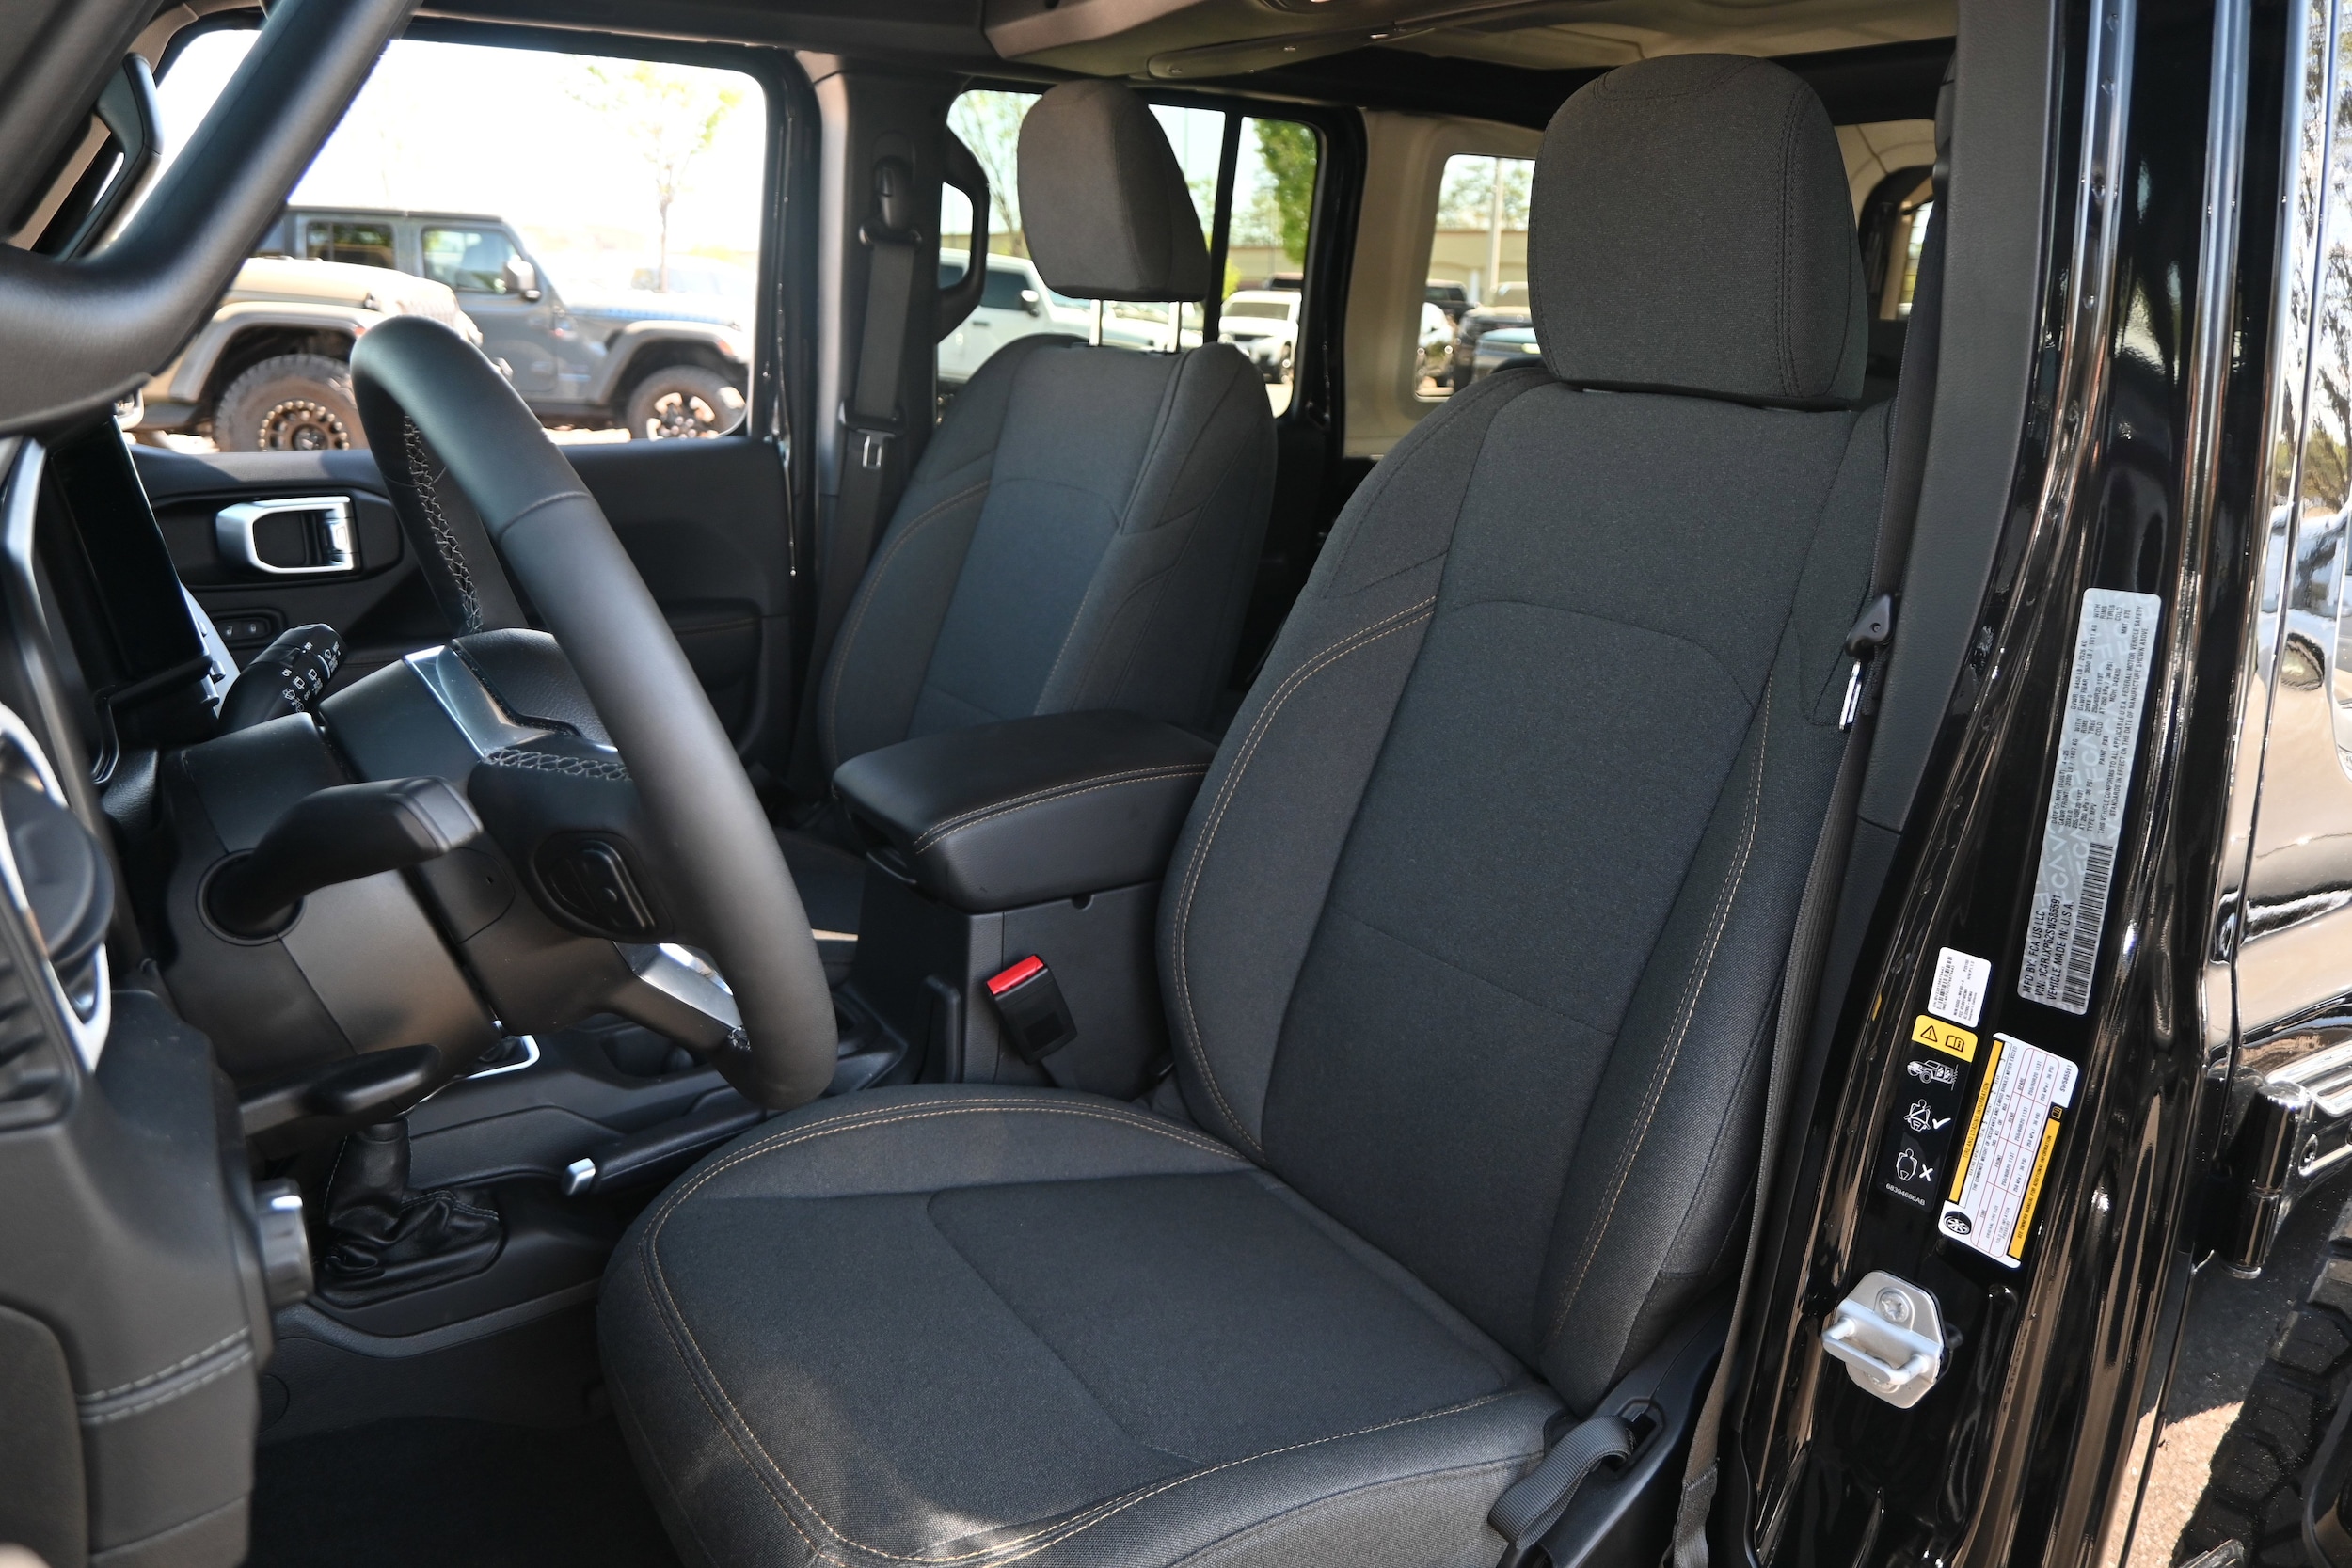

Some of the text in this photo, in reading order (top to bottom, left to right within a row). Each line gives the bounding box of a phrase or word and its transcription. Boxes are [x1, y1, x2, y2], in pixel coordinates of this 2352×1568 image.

[2092, 603, 2101, 618] WITH
[2099, 605, 2107, 619] RIMS
[2106, 603, 2115, 620] TIRES
[2114, 606, 2122, 621] COLD
[2133, 605, 2144, 626] SAFETY
[2129, 627, 2140, 650] VEHICLE
[2125, 651, 2136, 671] MOTOR
[2134, 646, 2146, 667] SHOWN
[2121, 672, 2133, 697] FEDERAL
[2127, 668, 2142, 709] MANUFACTURE
[2094, 721, 2103, 736] COLD
[2112, 716, 2125, 749] APPLICABLE
[2122, 719, 2133, 734] DATE
[2121, 734, 2130, 746] THE
[2110, 749, 2119, 760] ALL
[2115, 755, 2126, 776] EFFECT
[2103, 768, 2115, 799] CONFORMS
[2089, 802, 2097, 816] MPV
[2099, 799, 2109, 821] VEHICLE
[2107, 783, 2121, 816] STANDARDS
[2022, 908, 2045, 994] MFD BY: FCA US LLC
[2046, 898, 2074, 1002] VEHICLE MADE IN: U.S.A.
[2034, 977, 2046, 998] VIN:
[1962, 1081, 1990, 1159] TIRE AND LOADING INFORMATION
[1974, 1161, 1984, 1183] COMBINED
[1979, 1146, 1989, 1162] WEIGHT
[1986, 1115, 1997, 1140] OCCUPANTS
[1995, 1092, 2004, 1107] CARGO
[2000, 1075, 2010, 1093] SHOULD
[2005, 1061, 2013, 1076] NEVER
[2009, 1045, 2018, 1062] EXCEED
[1994, 1153, 2002, 1168] FRONT
[2019, 1212, 2028, 1231] OWNERS
[2024, 1196, 2034, 1213] MANUAL
[2032, 1163, 2043, 1187] ADDITIONAL
[2039, 1133, 2052, 1164] INFORMATION
